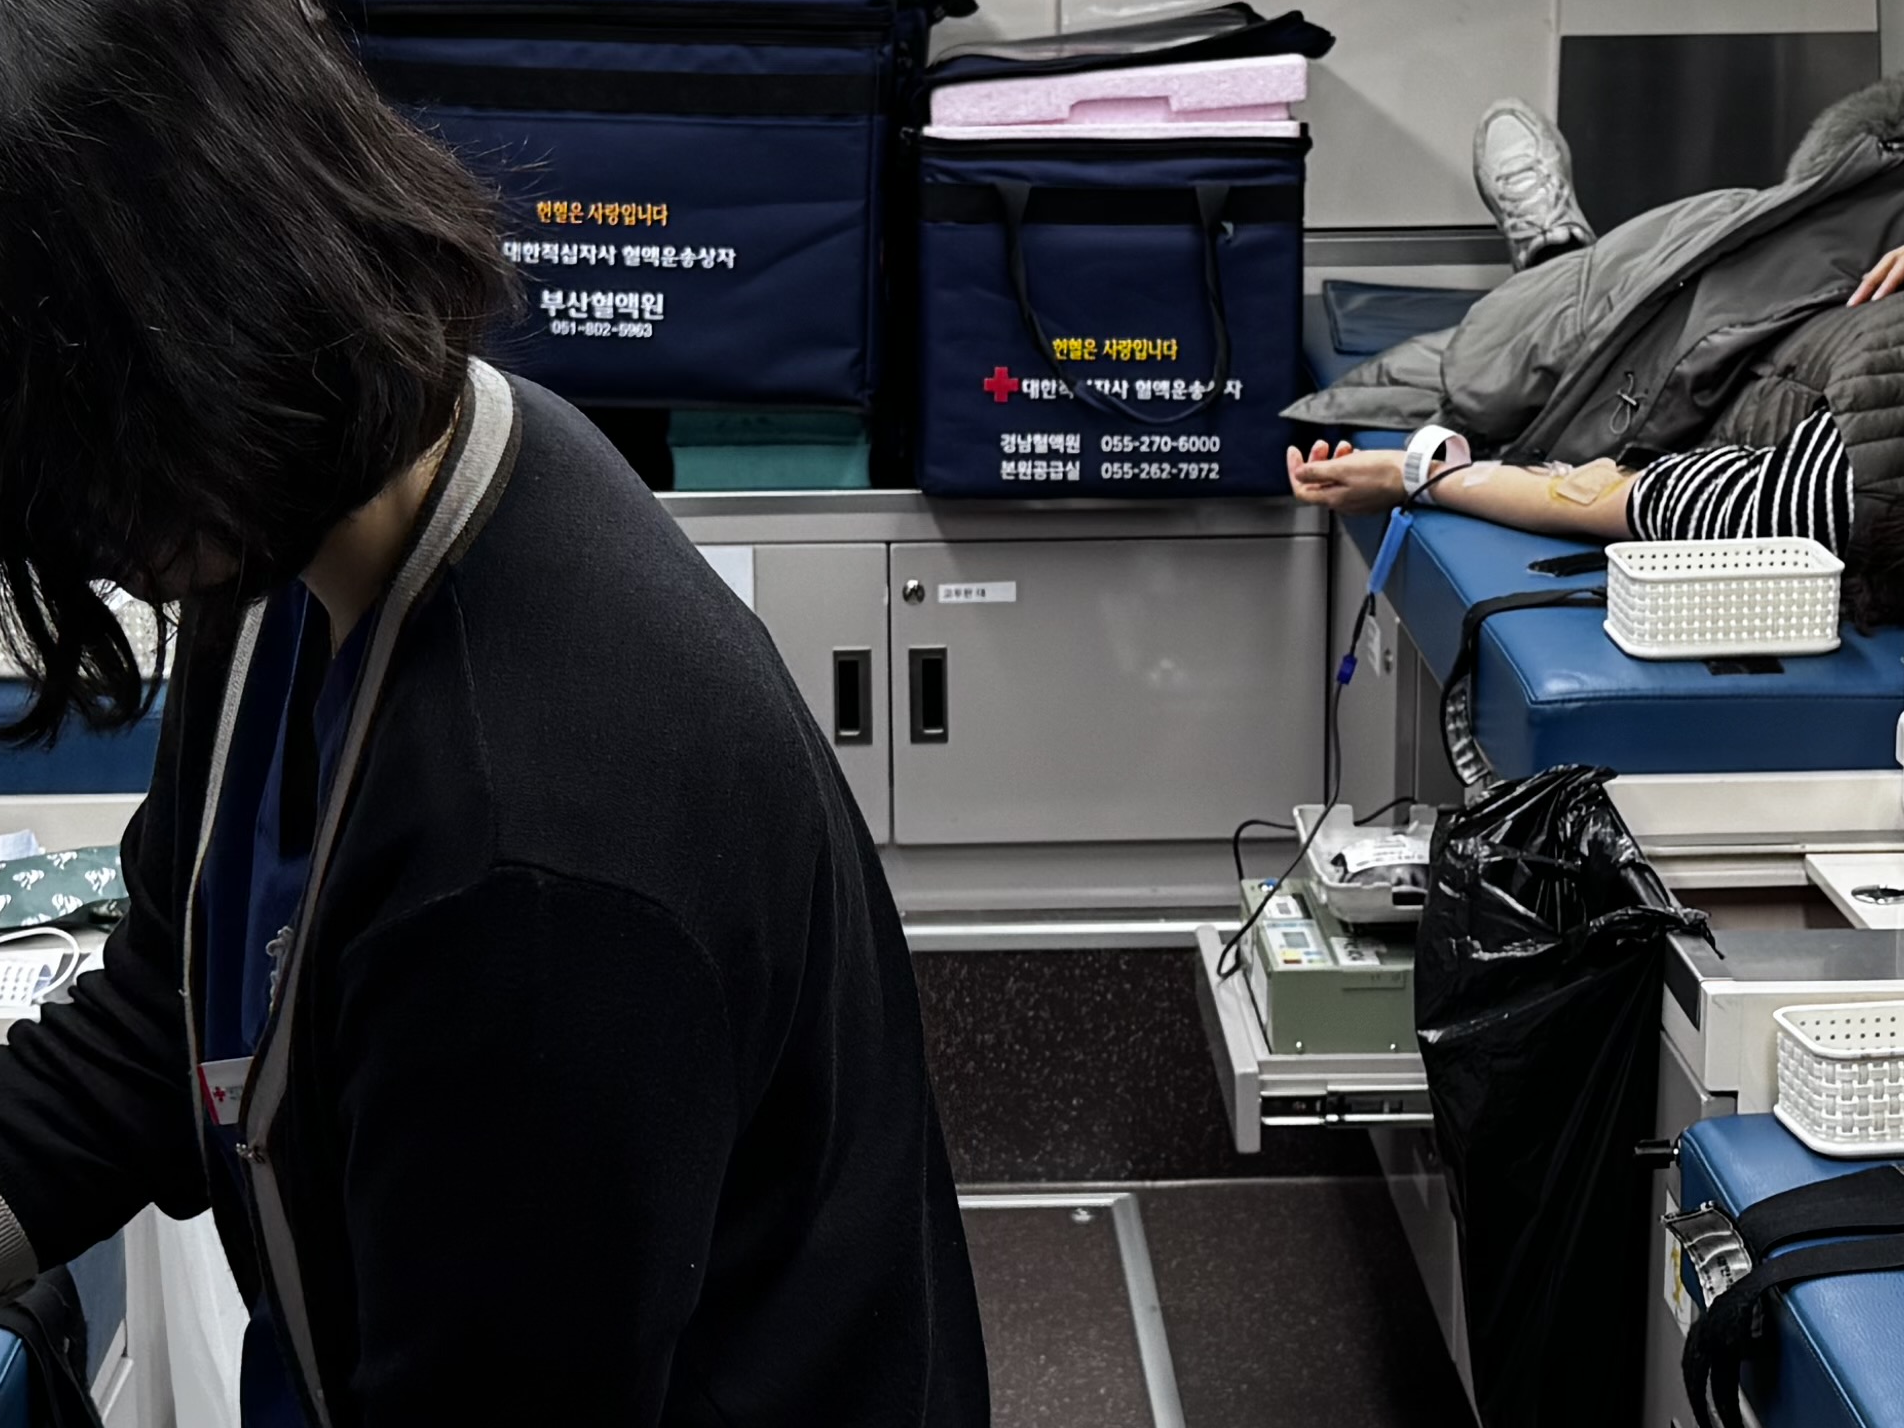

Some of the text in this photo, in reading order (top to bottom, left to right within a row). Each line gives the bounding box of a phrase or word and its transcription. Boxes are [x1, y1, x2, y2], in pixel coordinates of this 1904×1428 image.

[536, 200, 669, 227] 헌혈은 사랑입니다
[503, 241, 737, 269] 대한적십자사 혈액운송상자
[540, 289, 664, 320] 부산혈액원
[1052, 338, 1178, 361] 헌혈은 사랑입니다
[1135, 378, 1243, 401] 혈액운송자
[1100, 435, 1221, 453] 055-270-6000
[1101, 462, 1220, 480] 055-262-7972
